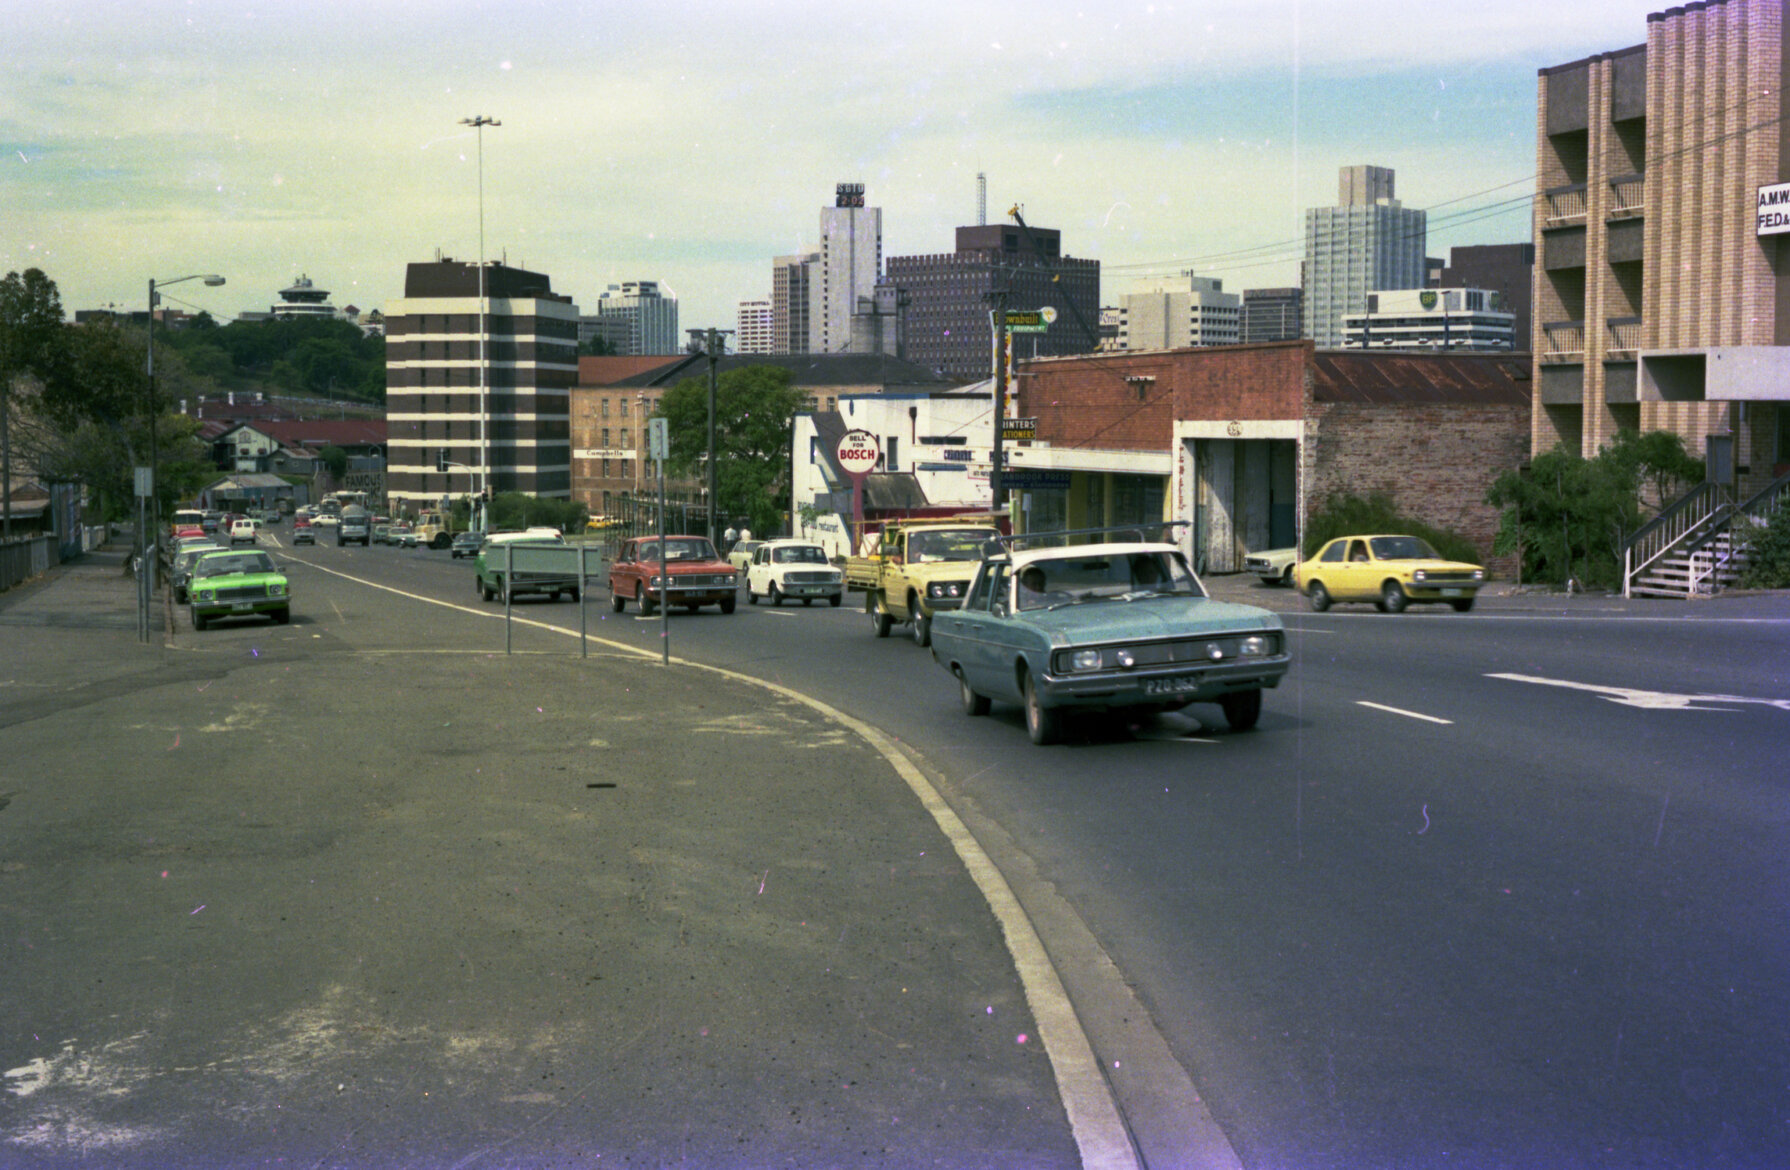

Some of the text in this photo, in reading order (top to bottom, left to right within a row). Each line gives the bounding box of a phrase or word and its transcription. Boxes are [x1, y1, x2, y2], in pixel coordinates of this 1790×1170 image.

[1422, 294, 1435, 304] BP
[995, 312, 1039, 324] Bownbuilt
[1002, 430, 1036, 439] ATIONERS
[840, 449, 875, 460] BOSCH
[345, 473, 382, 488] FAMOUS
